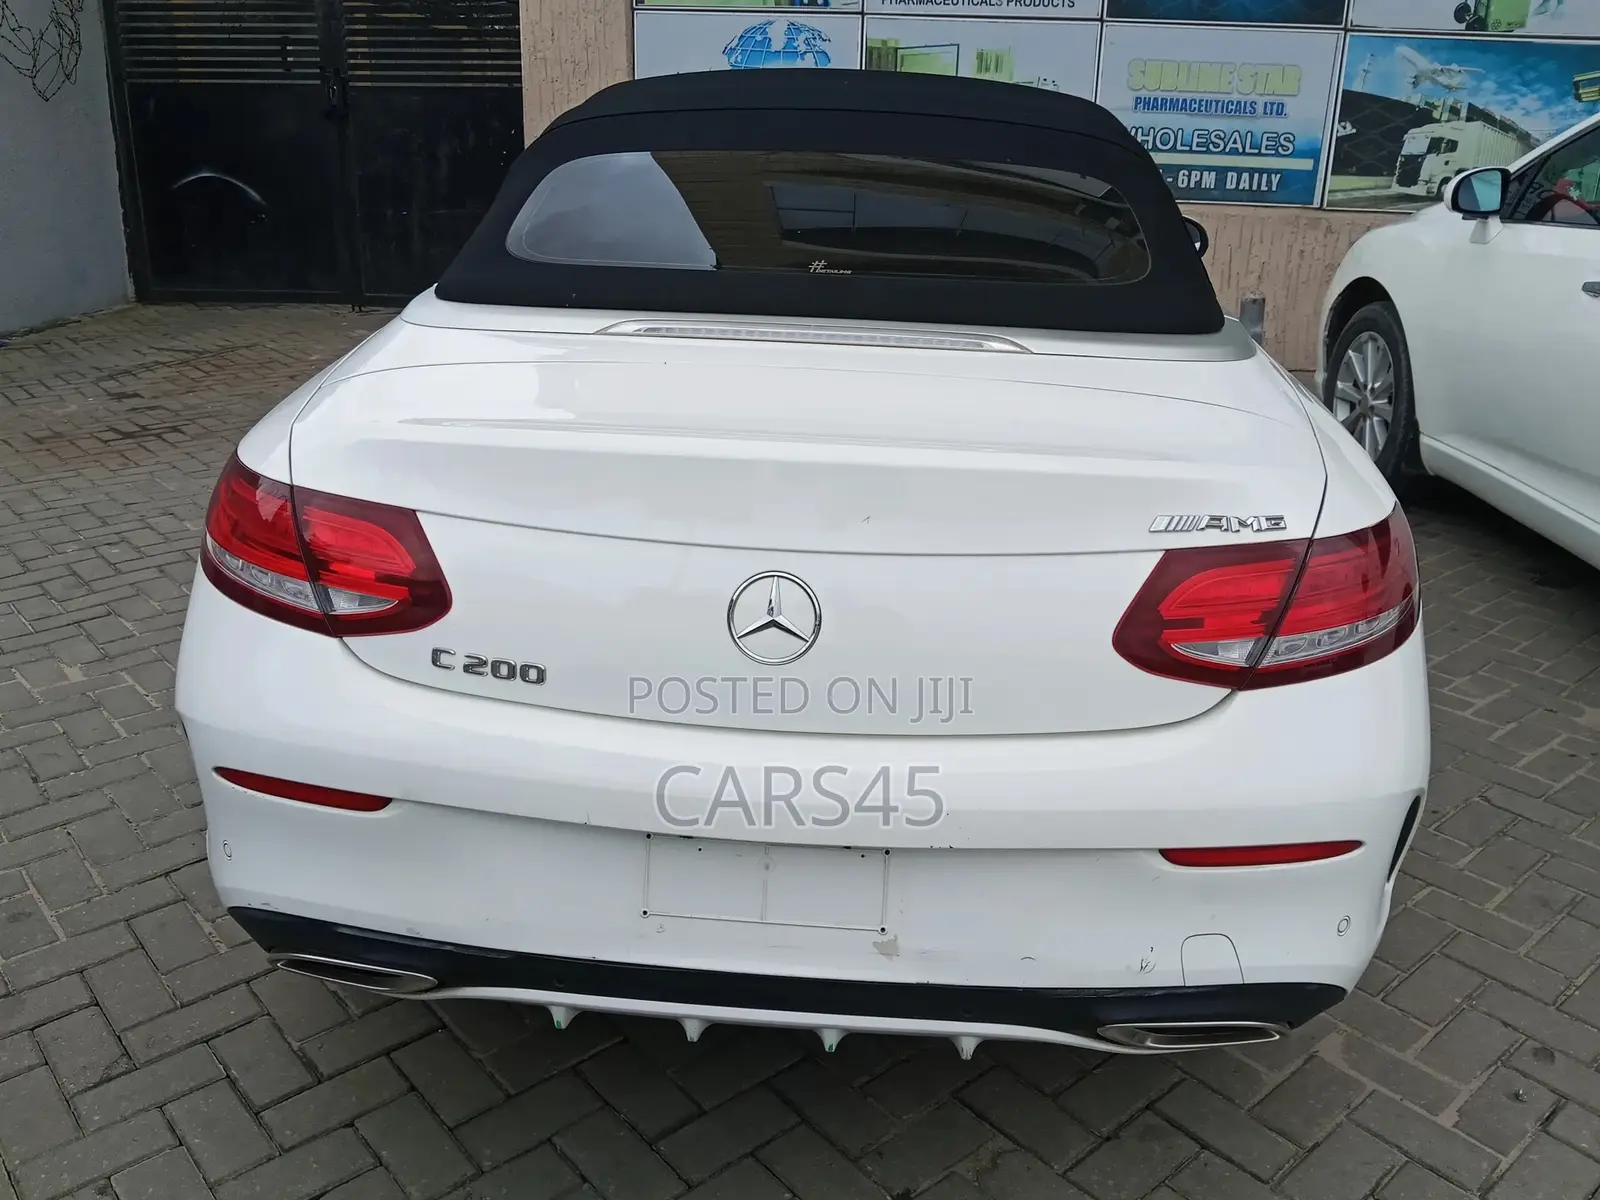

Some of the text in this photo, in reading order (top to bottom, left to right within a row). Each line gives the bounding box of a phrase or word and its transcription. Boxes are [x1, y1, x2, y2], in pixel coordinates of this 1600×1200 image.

[1127, 58, 1302, 97] SUBLIME STAR
[1133, 96, 1287, 117] PHARMACEUTICALS LTD.
[1130, 126, 1297, 155] HOLESALES
[1177, 169, 1217, 189] 6PM
[1225, 172, 1282, 192] DAILY
[1196, 514, 1288, 533] AMG
[431, 646, 547, 686] C 200
